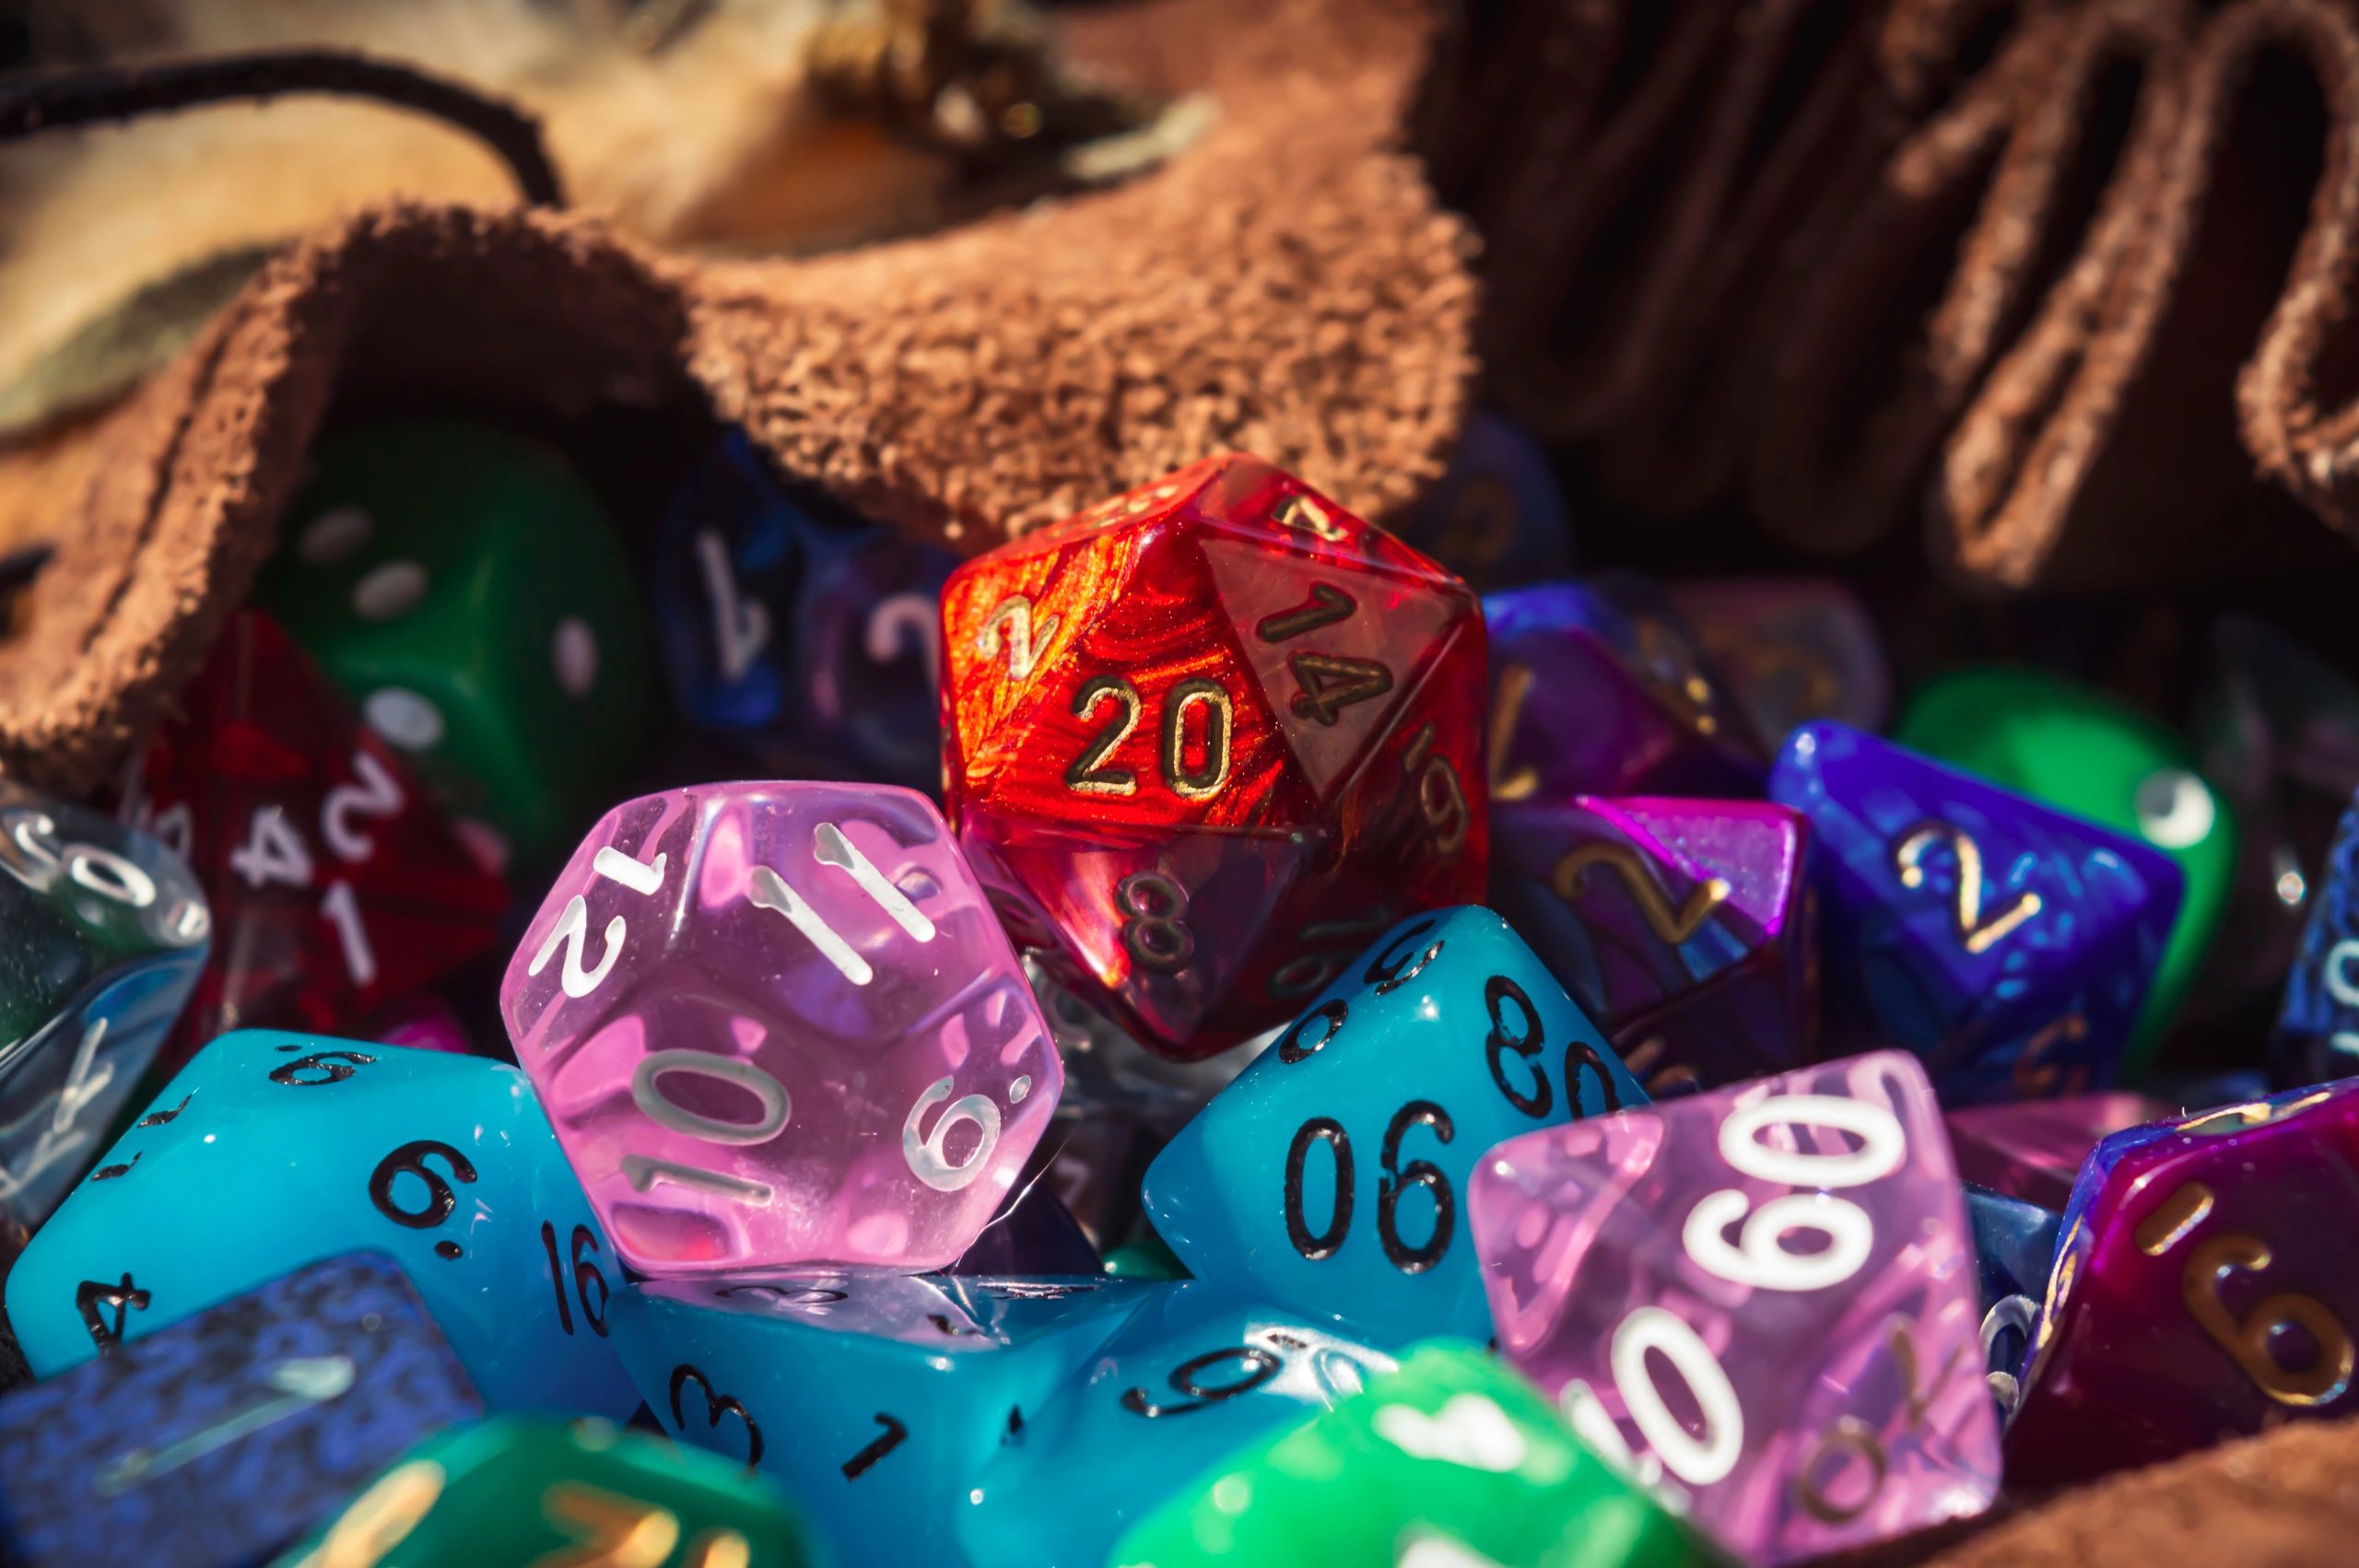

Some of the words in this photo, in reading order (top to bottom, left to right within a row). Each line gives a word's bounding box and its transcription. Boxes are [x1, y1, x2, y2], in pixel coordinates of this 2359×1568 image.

[979, 594, 1060, 682] 2
[1255, 582, 1393, 726] 14
[1064, 675, 1235, 800] 20
[528, 845, 667, 999] 12
[756, 822, 936, 986] 11
[1115, 871, 1196, 970] 8
[1895, 820, 2044, 954] 2
[620, 1047, 792, 1207] 10
[1682, 1094, 1907, 1291] 60
[540, 1218, 610, 1338] 16
